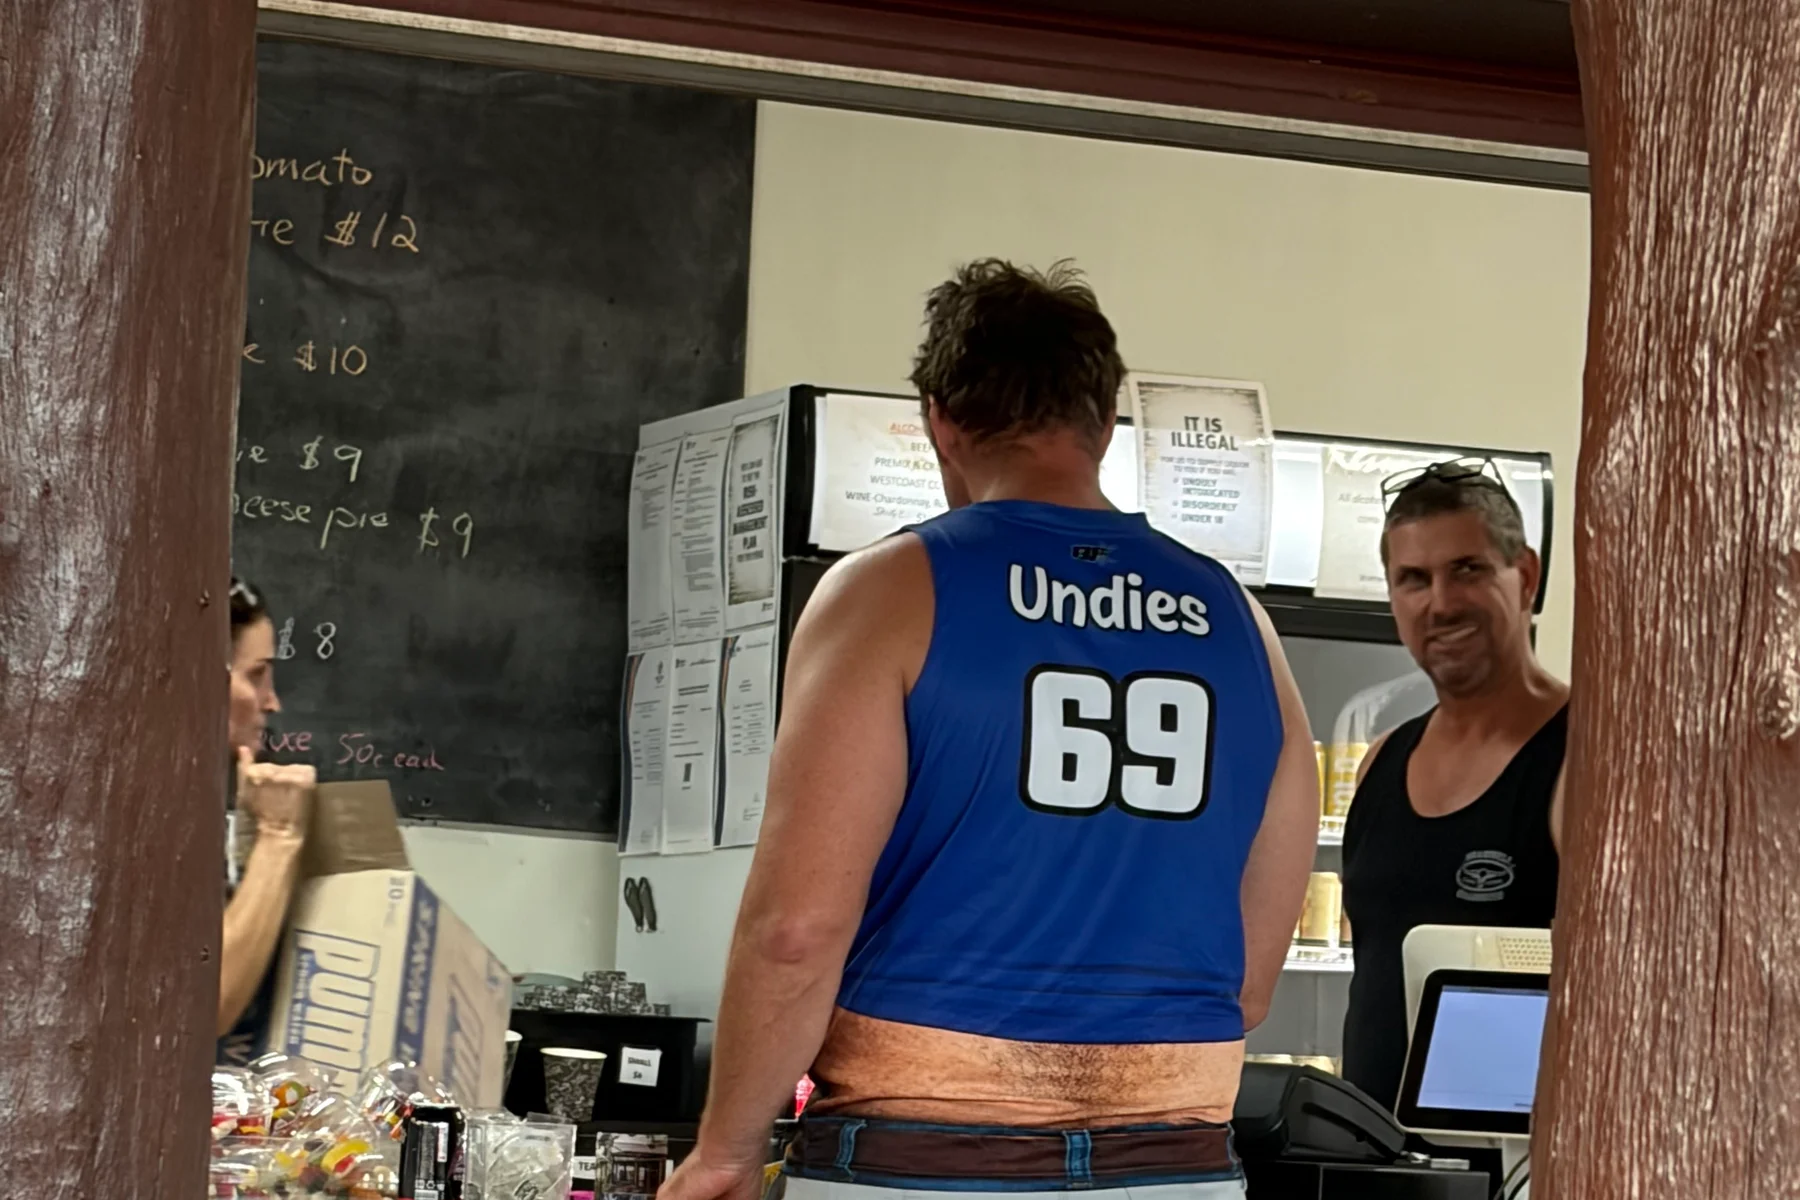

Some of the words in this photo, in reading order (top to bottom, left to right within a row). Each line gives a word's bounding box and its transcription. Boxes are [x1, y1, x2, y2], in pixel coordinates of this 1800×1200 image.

[251, 148, 373, 186] omato
[324, 211, 419, 253] $12
[293, 340, 367, 375] $10
[1171, 432, 1239, 451] ILLEGAL
[1184, 416, 1199, 431] IT
[1205, 417, 1222, 433] IS
[1181, 513, 1211, 524] UNDER
[1008, 562, 1212, 637] Undies
[1023, 667, 1214, 817] 69
